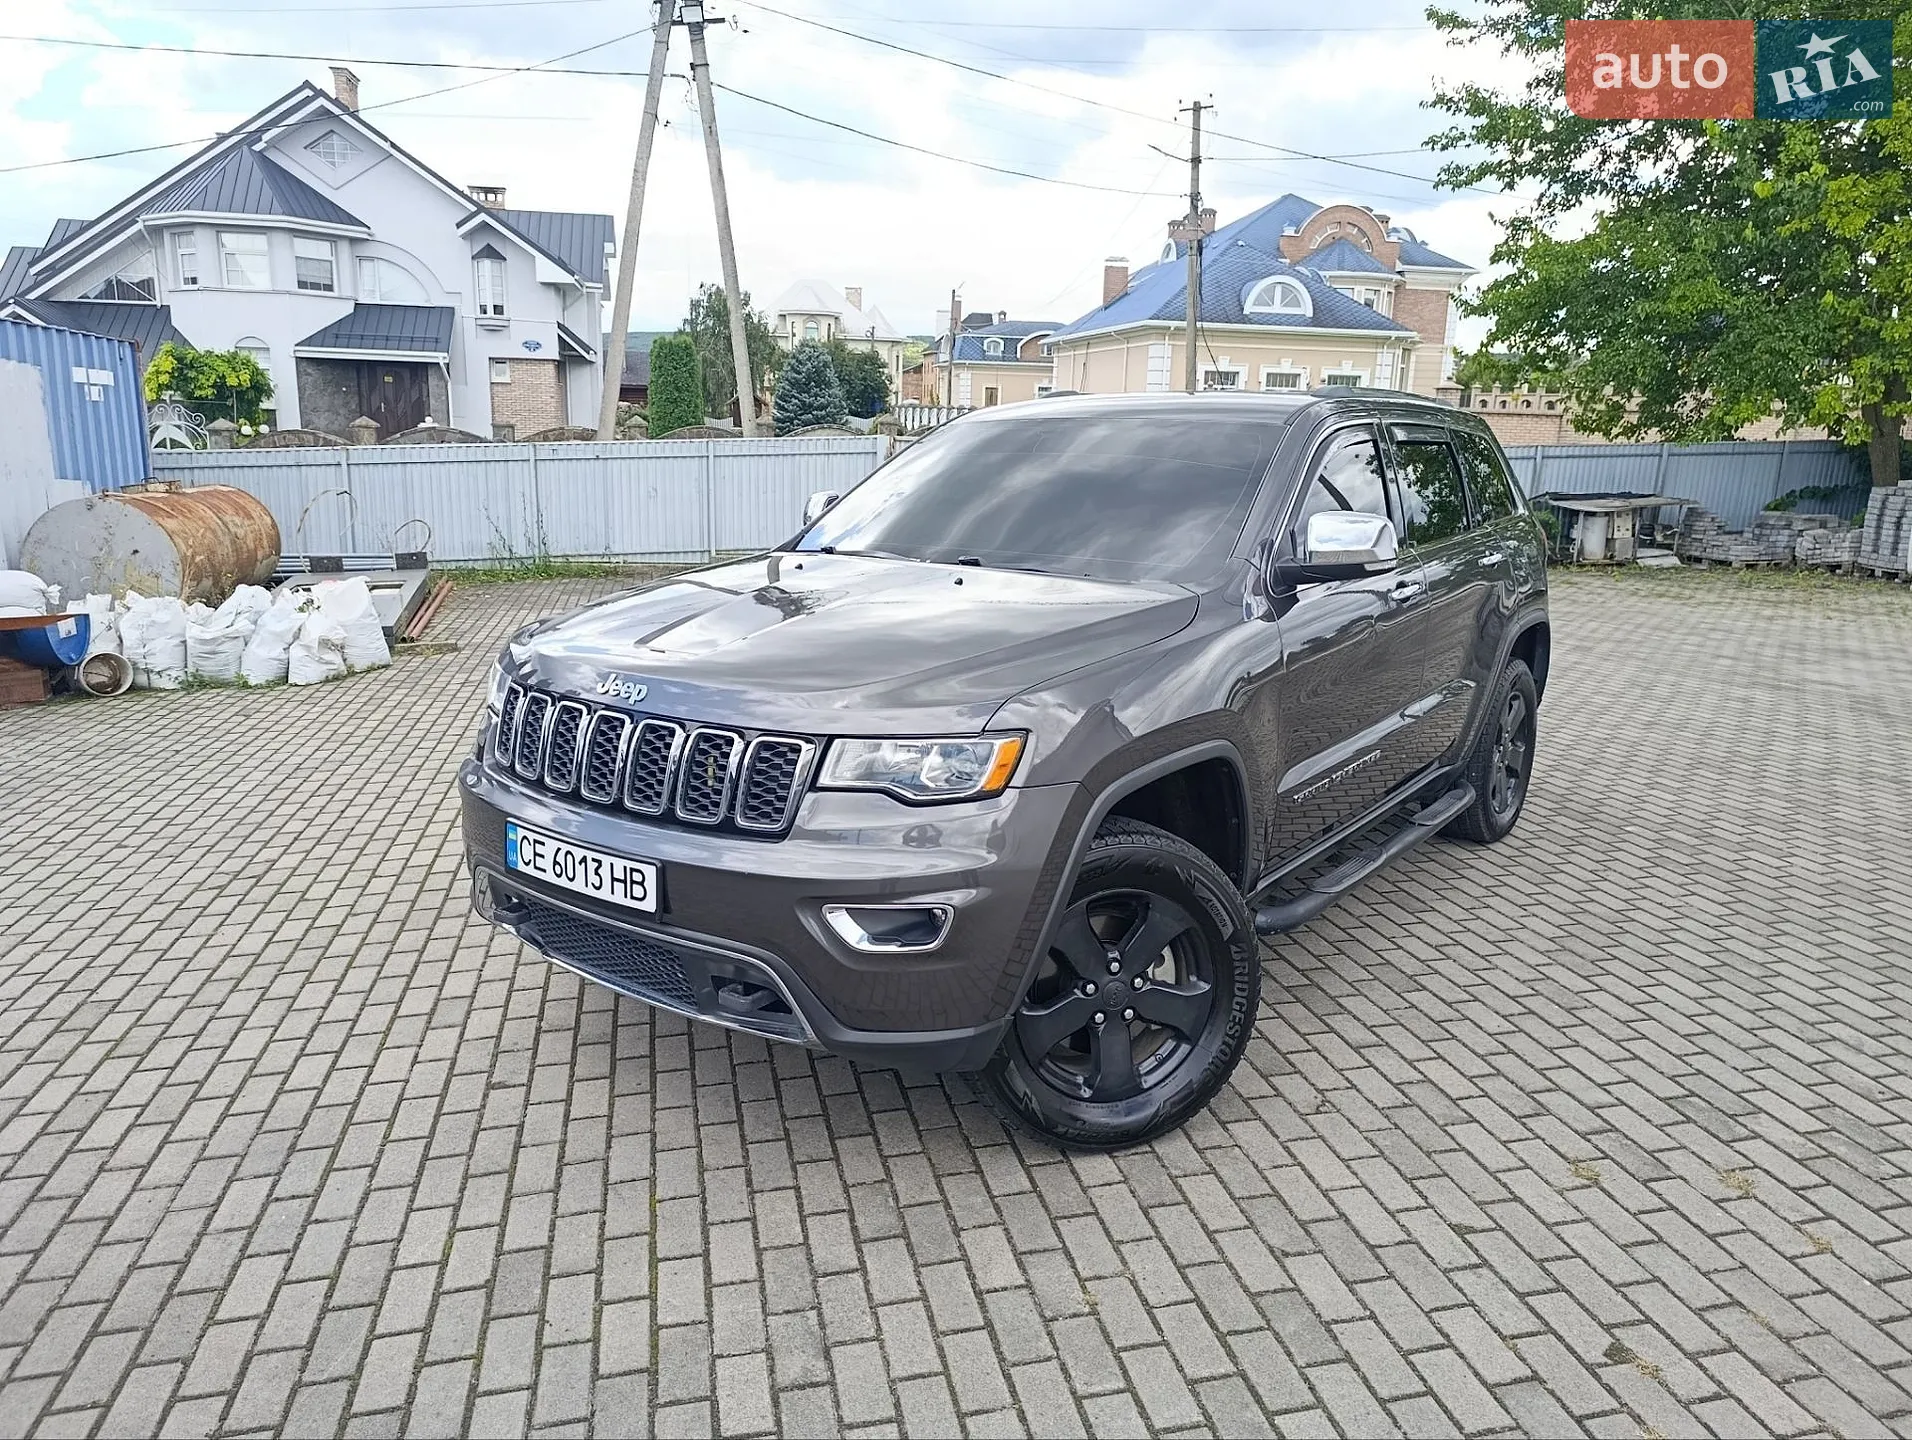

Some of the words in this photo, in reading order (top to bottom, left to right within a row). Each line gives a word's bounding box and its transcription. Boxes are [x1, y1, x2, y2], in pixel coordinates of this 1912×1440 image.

[596, 673, 648, 705] Jeep
[520, 835, 547, 873] CE
[552, 847, 603, 891] 6013
[610, 862, 647, 902] HB
[1202, 943, 1250, 1086] BRIDGESTONE
